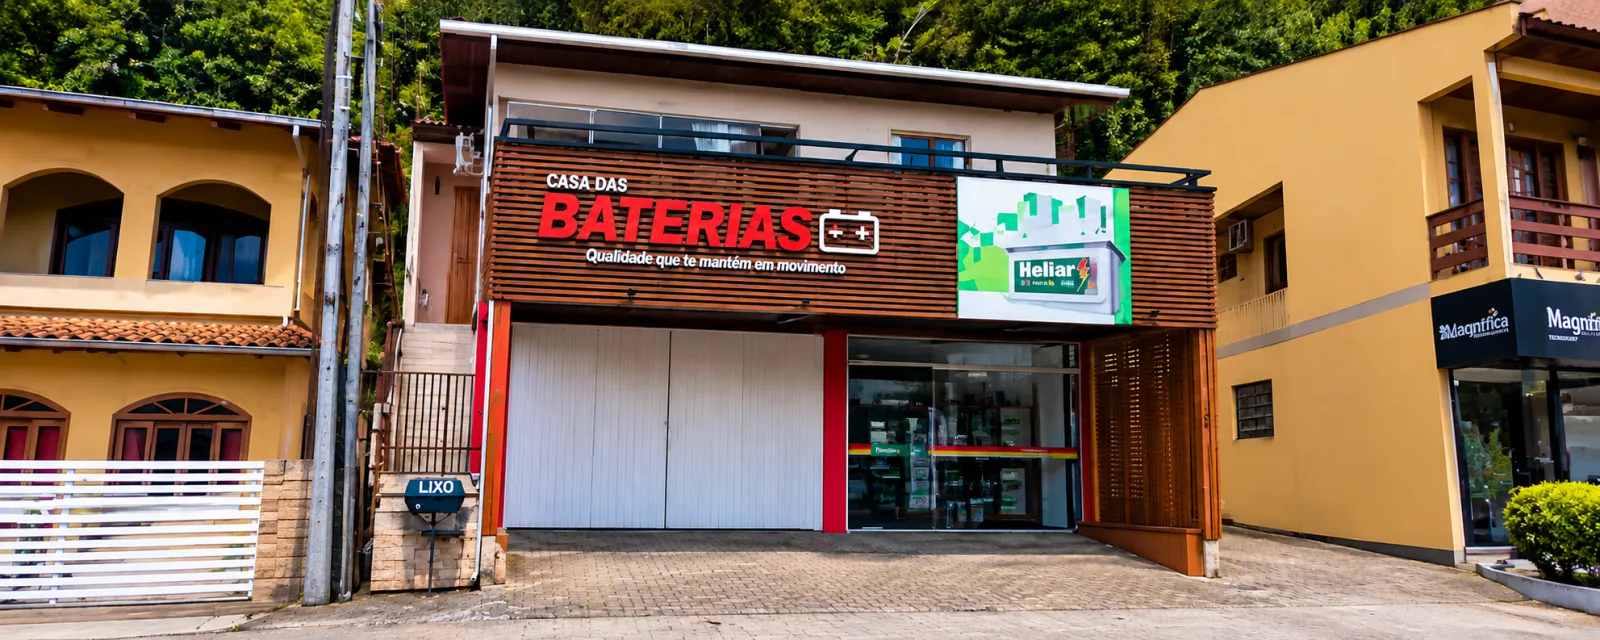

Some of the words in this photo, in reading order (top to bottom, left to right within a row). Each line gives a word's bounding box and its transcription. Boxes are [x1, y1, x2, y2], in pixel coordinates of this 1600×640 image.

[546, 173, 591, 191] CASA
[594, 176, 628, 193] DAS
[538, 191, 813, 252] BATERIAS
[585, 248, 653, 265] Qualidade
[655, 255, 680, 269] que
[682, 254, 696, 267] te
[698, 255, 751, 271] mantém
[753, 260, 774, 271] em
[776, 260, 846, 275] movimento
[1019, 261, 1076, 278] Heliar
[418, 480, 454, 494] LIXO
